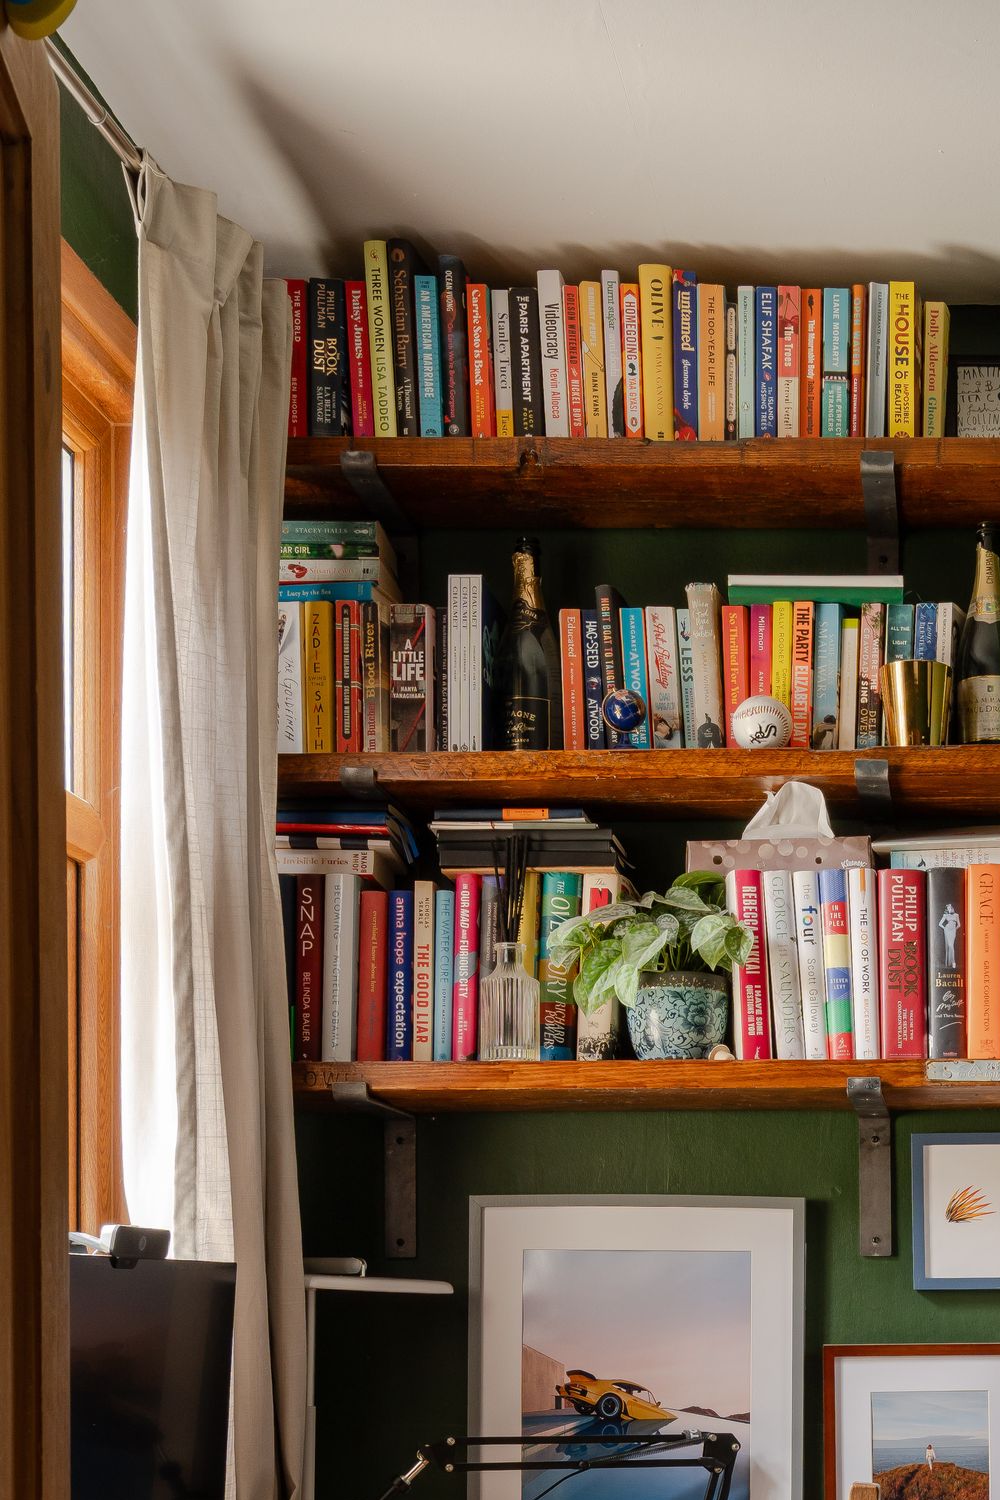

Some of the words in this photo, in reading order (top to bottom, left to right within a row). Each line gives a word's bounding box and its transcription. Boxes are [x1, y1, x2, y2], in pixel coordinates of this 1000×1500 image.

[371, 268, 382, 300] THREE
[421, 290, 430, 301] AN
[316, 284, 326, 328] PULLMAN
[326, 290, 334, 321] PHILIP
[352, 290, 361, 322] Daisy
[394, 270, 407, 333] Sebastian
[471, 289, 480, 324] Carrie
[762, 293, 772, 316] ELIF
[373, 306, 384, 352] WOMEN
[421, 305, 432, 350] AMERICAN
[496, 312, 508, 354] Stanley
[519, 304, 528, 334] PARIS
[544, 303, 560, 360] Videocracy
[624, 301, 638, 360] HOMEGOING
[784, 324, 794, 342] The
[894, 304, 910, 366] HOUSE
[927, 310, 939, 338] Dolly
[354, 324, 364, 359] Jones
[396, 334, 409, 368] Barry
[473, 326, 482, 348] Soto
[474, 350, 482, 358] is
[762, 320, 772, 370] SHAFAK
[314, 340, 326, 372] DUST
[326, 338, 338, 376] BOOK
[376, 358, 386, 380] LISA
[520, 336, 532, 402] APARTMENT
[784, 344, 792, 366] Trees
[928, 342, 938, 391] Alderton
[423, 354, 434, 398] MARRIAGE
[474, 360, 484, 386] Back
[499, 357, 511, 389] Tucci
[549, 368, 559, 388] Kevin
[628, 375, 636, 390] YAA
[895, 371, 908, 379] OF
[378, 384, 389, 431] TADDEO
[550, 390, 560, 419] Allocca
[628, 391, 637, 412] GYASI
[784, 380, 792, 404] Percival
[784, 408, 792, 431] Everett
[928, 396, 938, 436] Ghosts
[729, 612, 736, 624] So
[797, 607, 810, 626] THE
[312, 614, 320, 672] ZADIE
[366, 622, 374, 659] River
[405, 639, 412, 650] A
[567, 616, 576, 657] Educated
[586, 620, 598, 668] HAG-SEED
[730, 626, 738, 666] Thrilled
[796, 628, 810, 663] PARTY
[862, 628, 870, 678] CRAWDADS
[392, 652, 424, 662] LITTLE
[681, 648, 693, 682] LESS
[870, 639, 879, 670] WHERE
[366, 663, 376, 698] Blood
[392, 664, 424, 680] LIFE
[731, 687, 740, 704] You
[794, 665, 808, 720] ELIZABETH
[312, 690, 324, 750] SMITH
[588, 698, 600, 740] ATWOOD
[794, 722, 806, 743] DAY
[860, 708, 868, 745] OWENS
[868, 710, 876, 740] DELIA
[556, 880, 564, 894] THE
[300, 888, 315, 956] SNAP
[332, 885, 340, 940] BECOMING
[396, 897, 404, 928] anna
[802, 906, 818, 944] four
[860, 908, 868, 926] THE
[892, 876, 904, 942] PULLMAN
[904, 886, 917, 932] PHILIP
[394, 932, 406, 965] hope
[547, 896, 570, 1000] OVEORY
[861, 928, 869, 946] JOY
[417, 944, 430, 968] THE
[772, 876, 787, 938] GEORGE
[780, 961, 796, 1044] SAUNDERS
[807, 958, 816, 984] Scott
[862, 949, 869, 962] OF
[888, 948, 902, 991] DUST
[302, 972, 310, 1010] BELINDA
[332, 956, 340, 1005] MICHELLE
[416, 972, 428, 1008] GOOD
[862, 966, 870, 994] WORK
[936, 978, 964, 987] Bacall
[394, 971, 406, 1047] expectation
[554, 1001, 566, 1044] RICHARD
[808, 988, 818, 1034] Galloway
[302, 1012, 310, 1042] BAUER
[331, 1010, 339, 1048] OBAMA
[416, 1012, 428, 1044] LIAR
[544, 1010, 556, 1050] POWERS
